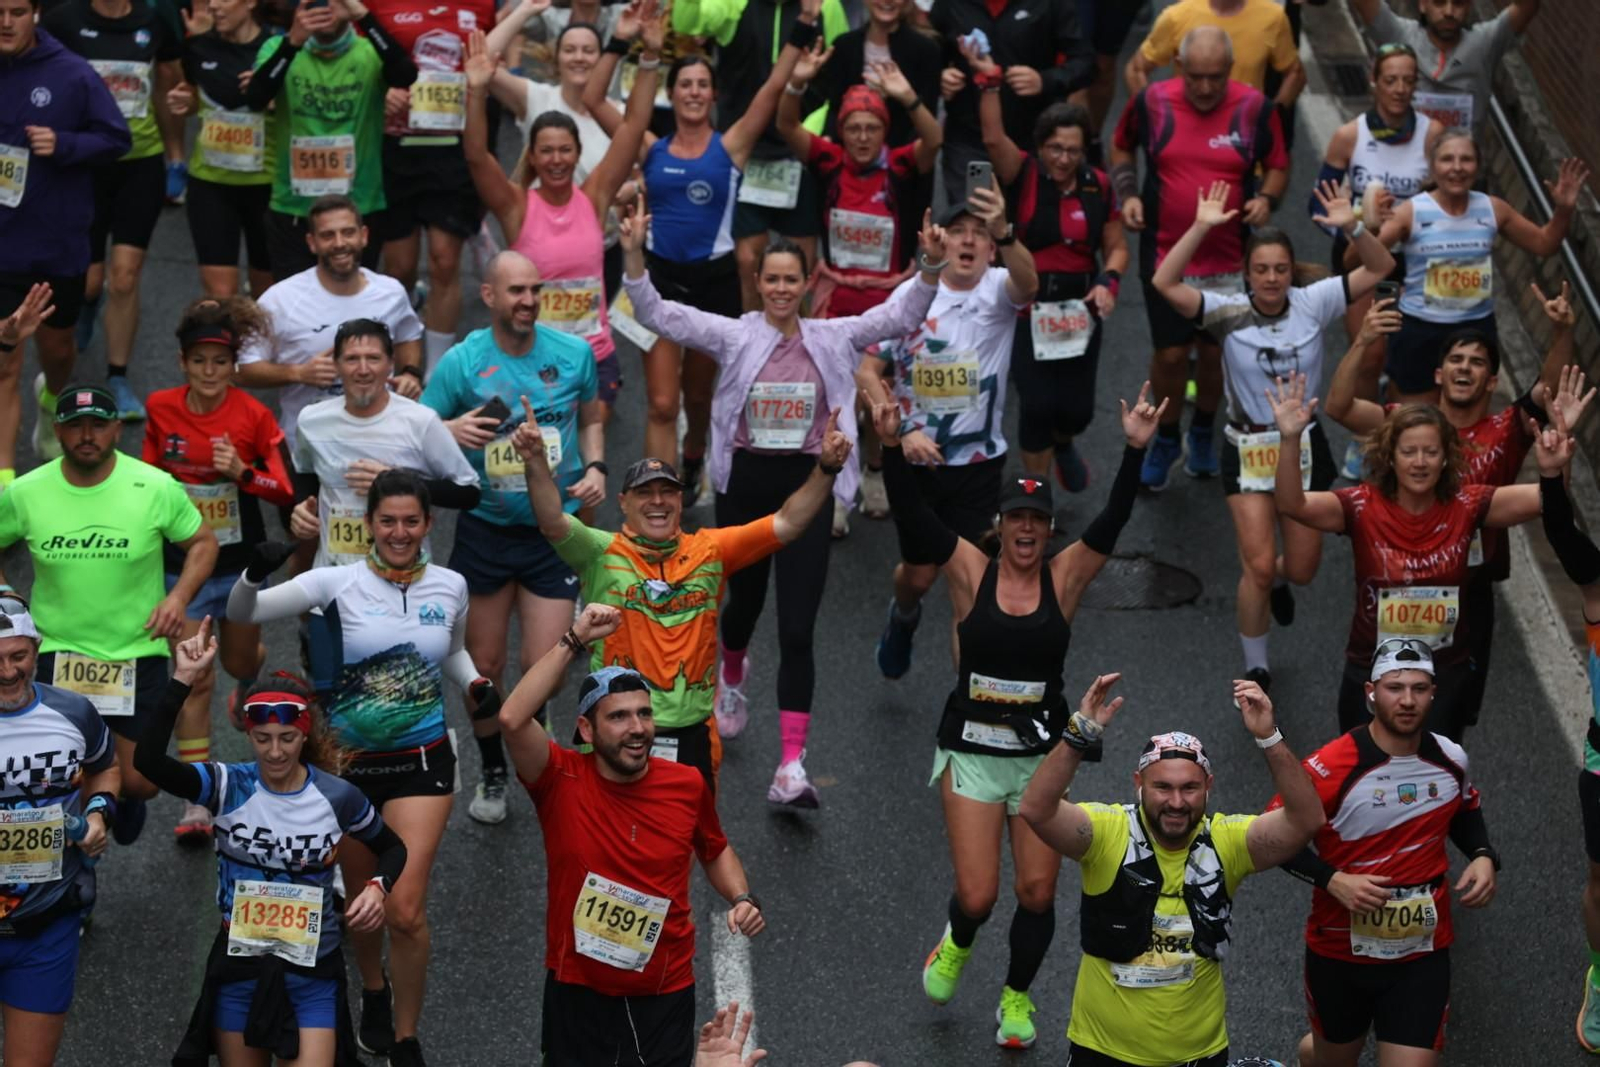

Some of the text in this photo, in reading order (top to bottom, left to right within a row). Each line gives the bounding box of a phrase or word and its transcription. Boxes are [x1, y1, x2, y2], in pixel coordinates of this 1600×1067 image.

[207, 125, 253, 145] 12408
[300, 151, 339, 169] 5116
[1433, 268, 1481, 289] 11266
[542, 292, 592, 311] 12755
[917, 367, 968, 388] 13913
[750, 399, 805, 419] 17726
[1385, 603, 1446, 624] 10740
[62, 661, 122, 684] 10627
[348, 763, 416, 775] WONG
[241, 900, 308, 930] 13285
[586, 895, 648, 937] 11591
